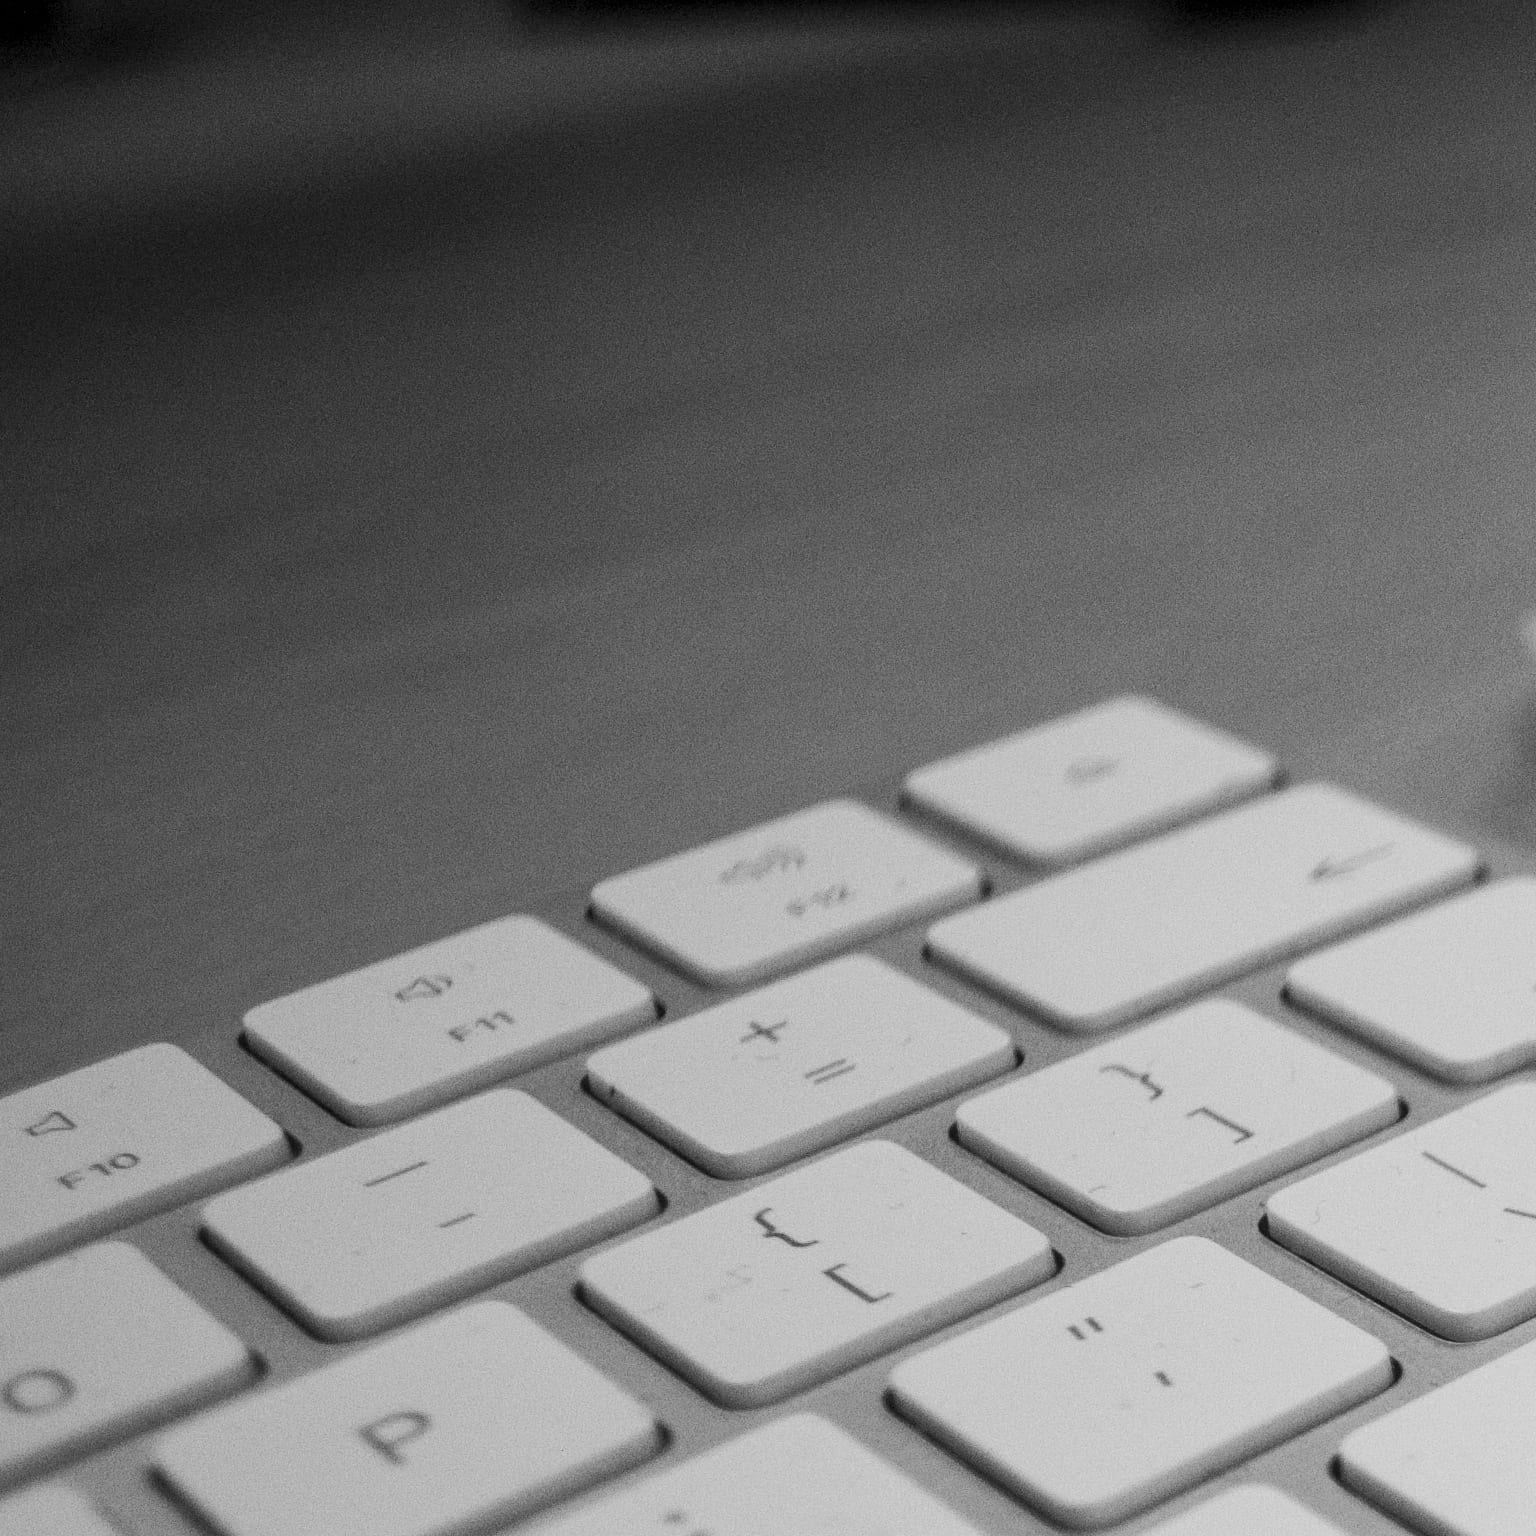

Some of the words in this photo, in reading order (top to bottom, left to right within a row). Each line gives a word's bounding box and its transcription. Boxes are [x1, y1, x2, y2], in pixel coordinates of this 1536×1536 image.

[448, 1008, 516, 1044] F11
[740, 1018, 788, 1046] +
[803, 1056, 857, 1086] =
[1186, 1104, 1256, 1145] ]
[56, 1151, 142, 1192] F10
[822, 1261, 893, 1306] [
[357, 1409, 432, 1466] P
